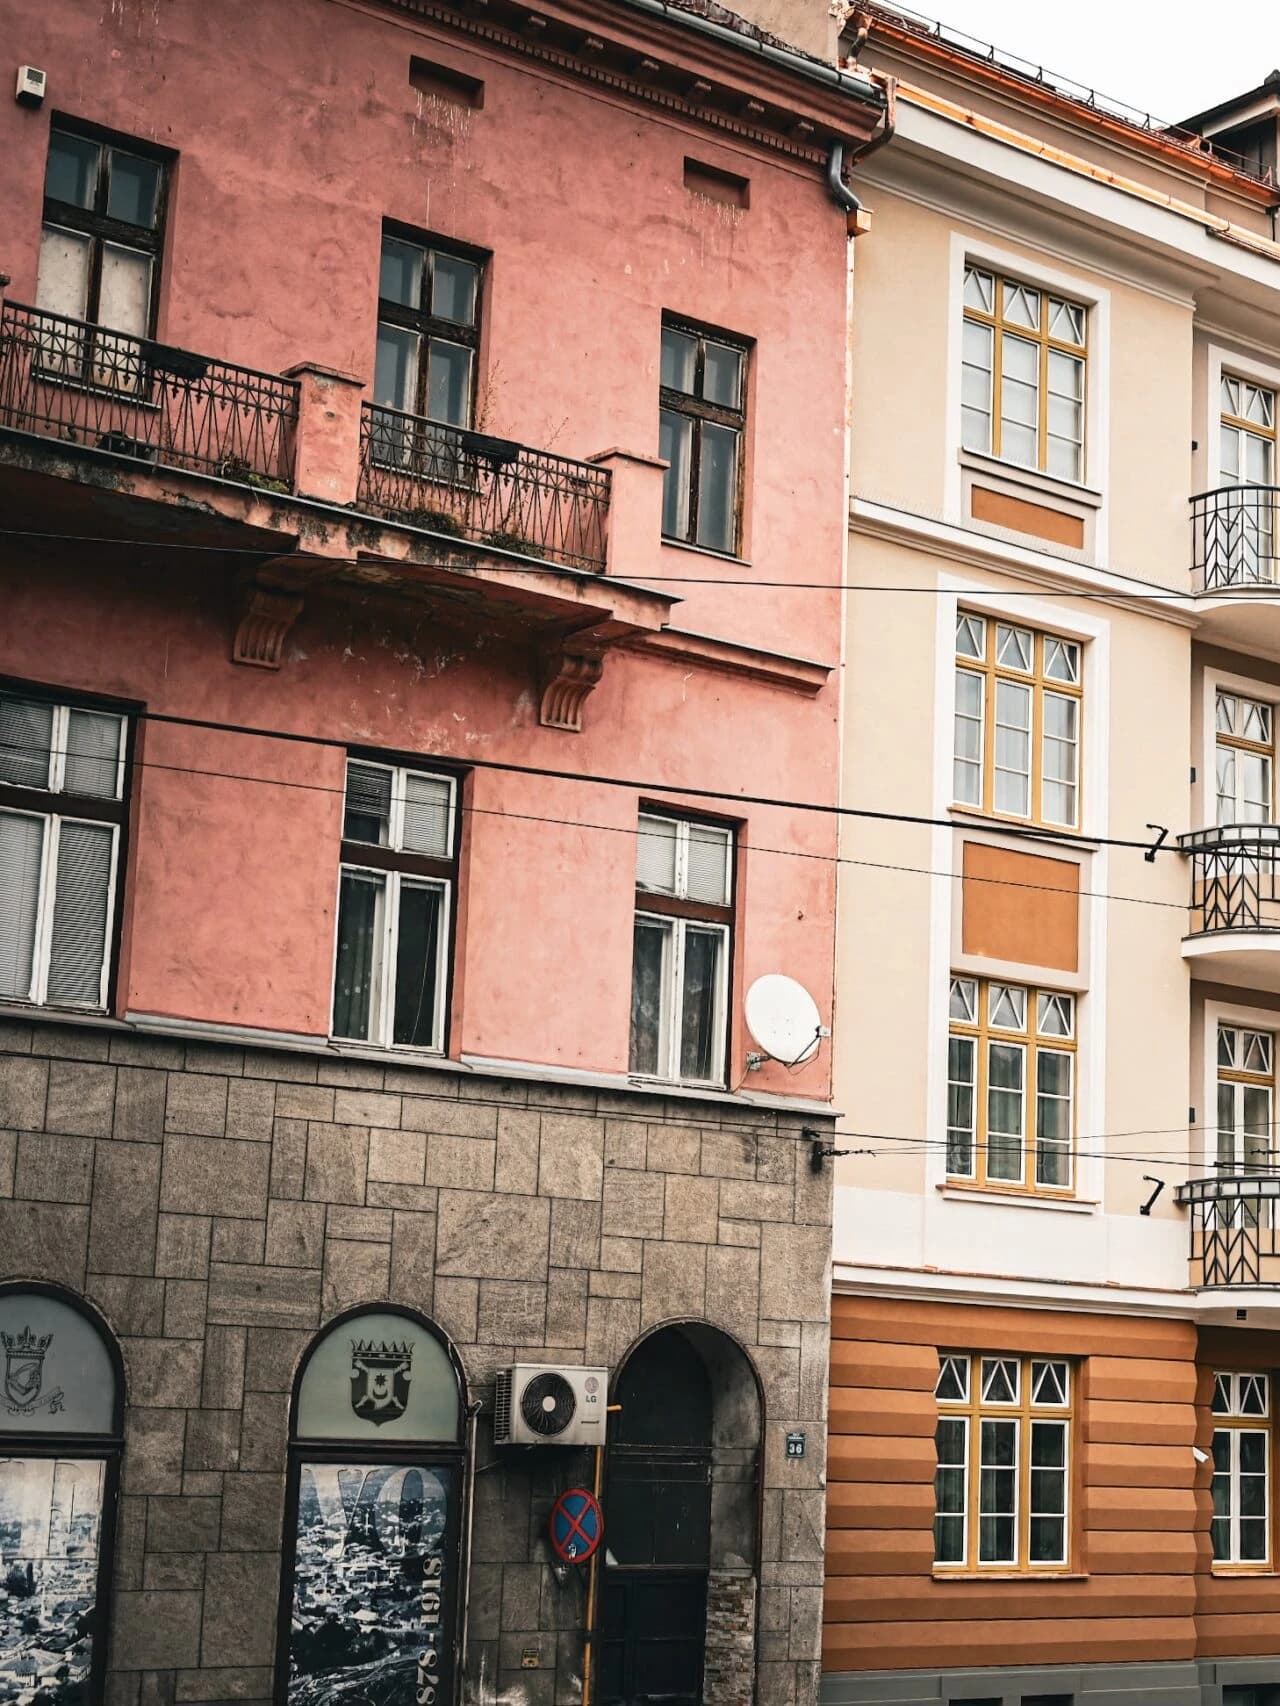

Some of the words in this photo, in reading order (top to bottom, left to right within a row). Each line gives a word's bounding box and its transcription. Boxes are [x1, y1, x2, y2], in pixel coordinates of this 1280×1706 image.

[585, 1394, 597, 1403] LG
[789, 1443, 802, 1454] 36
[415, 1648, 440, 1706] 878
